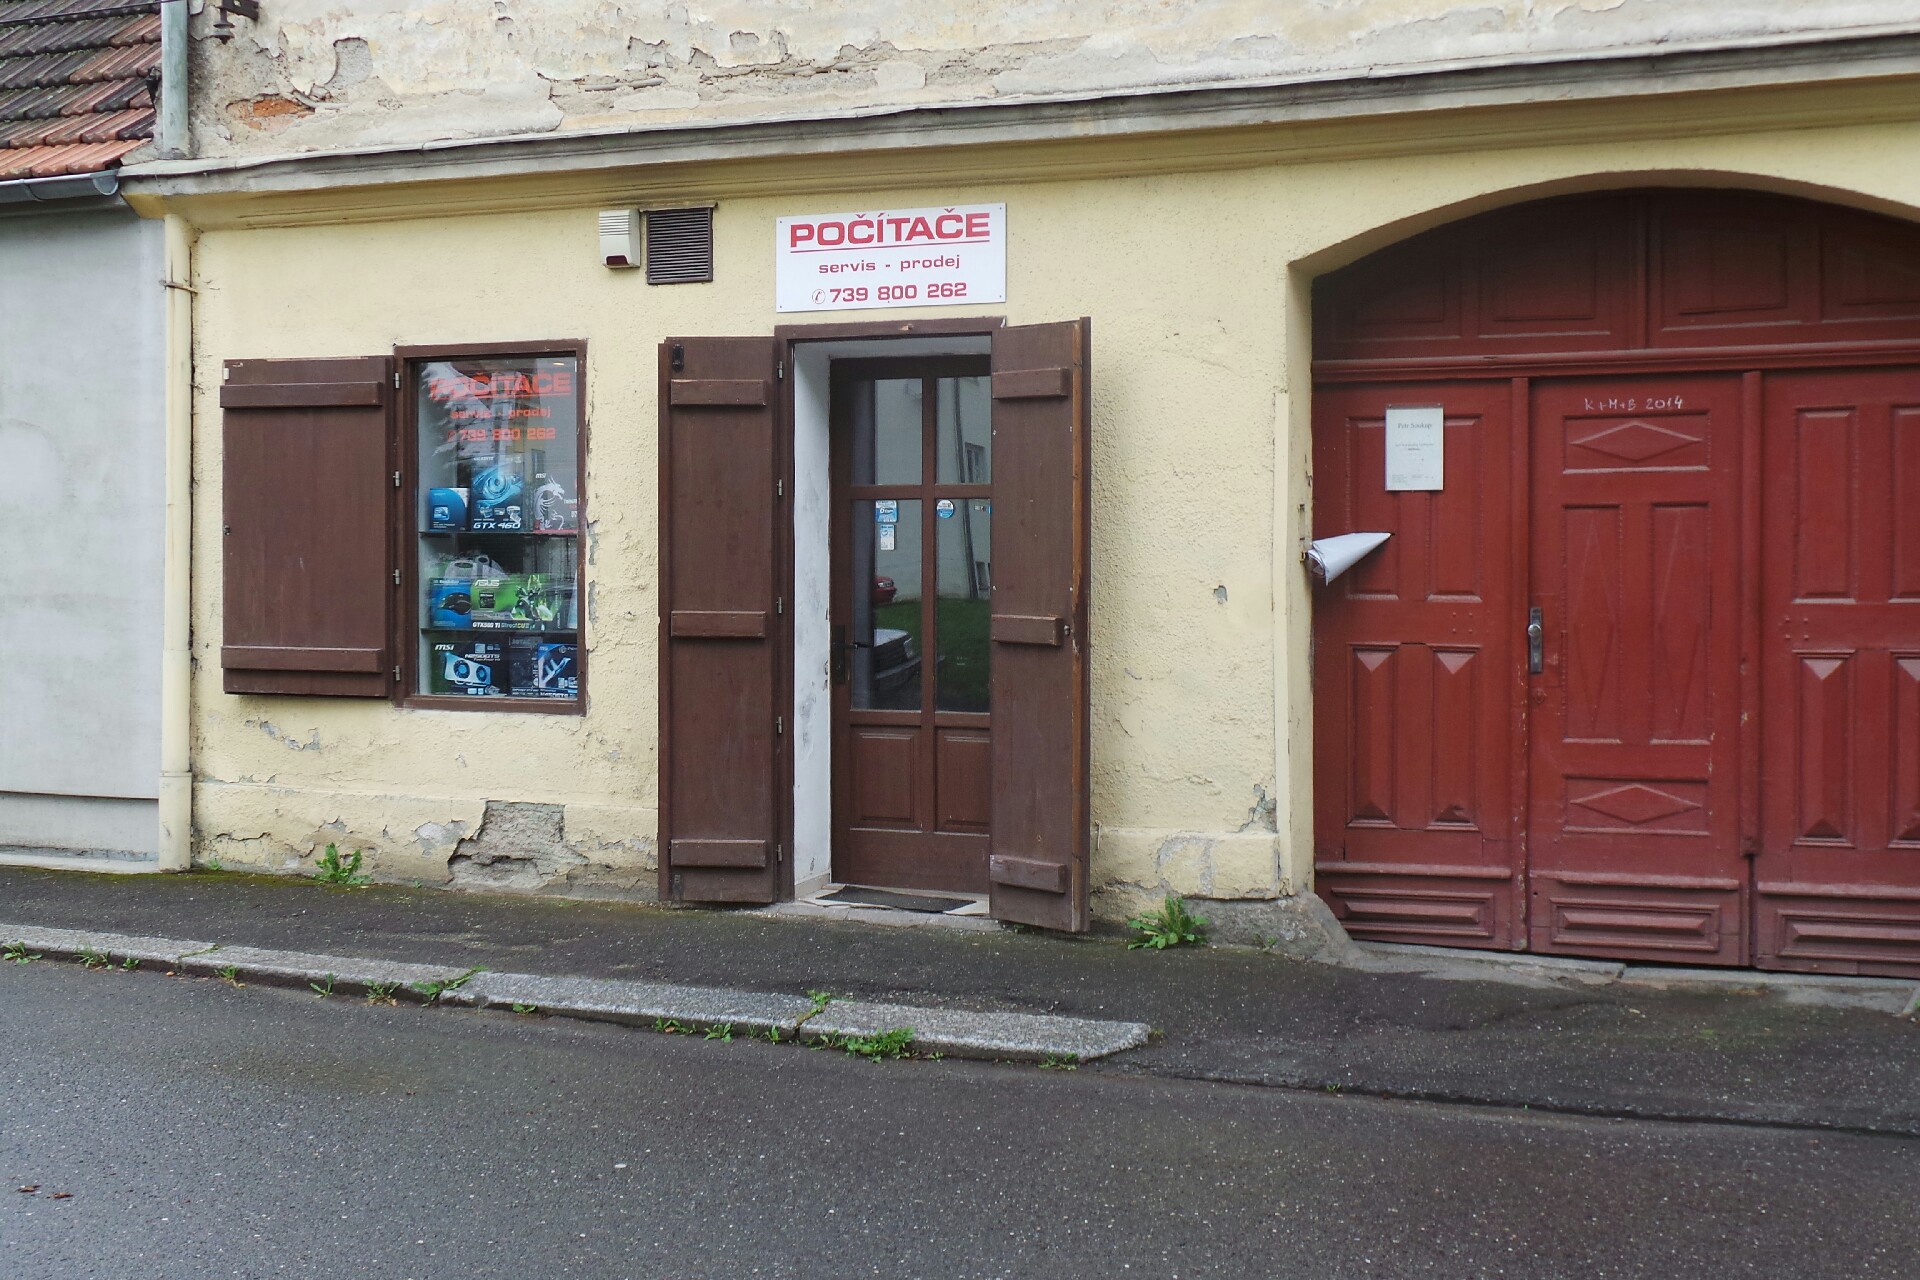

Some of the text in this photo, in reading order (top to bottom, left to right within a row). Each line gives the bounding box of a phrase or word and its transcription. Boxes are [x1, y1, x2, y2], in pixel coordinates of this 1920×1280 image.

[790, 208, 990, 247] POČÍTAČE
[818, 260, 876, 273] servis
[900, 255, 960, 272] prodej
[829, 282, 967, 302] 739 800 262
[1645, 395, 1683, 410] 2014
[508, 406, 551, 419] prodej
[460, 427, 556, 442] 739 800 262
[474, 579, 500, 587] ASUS
